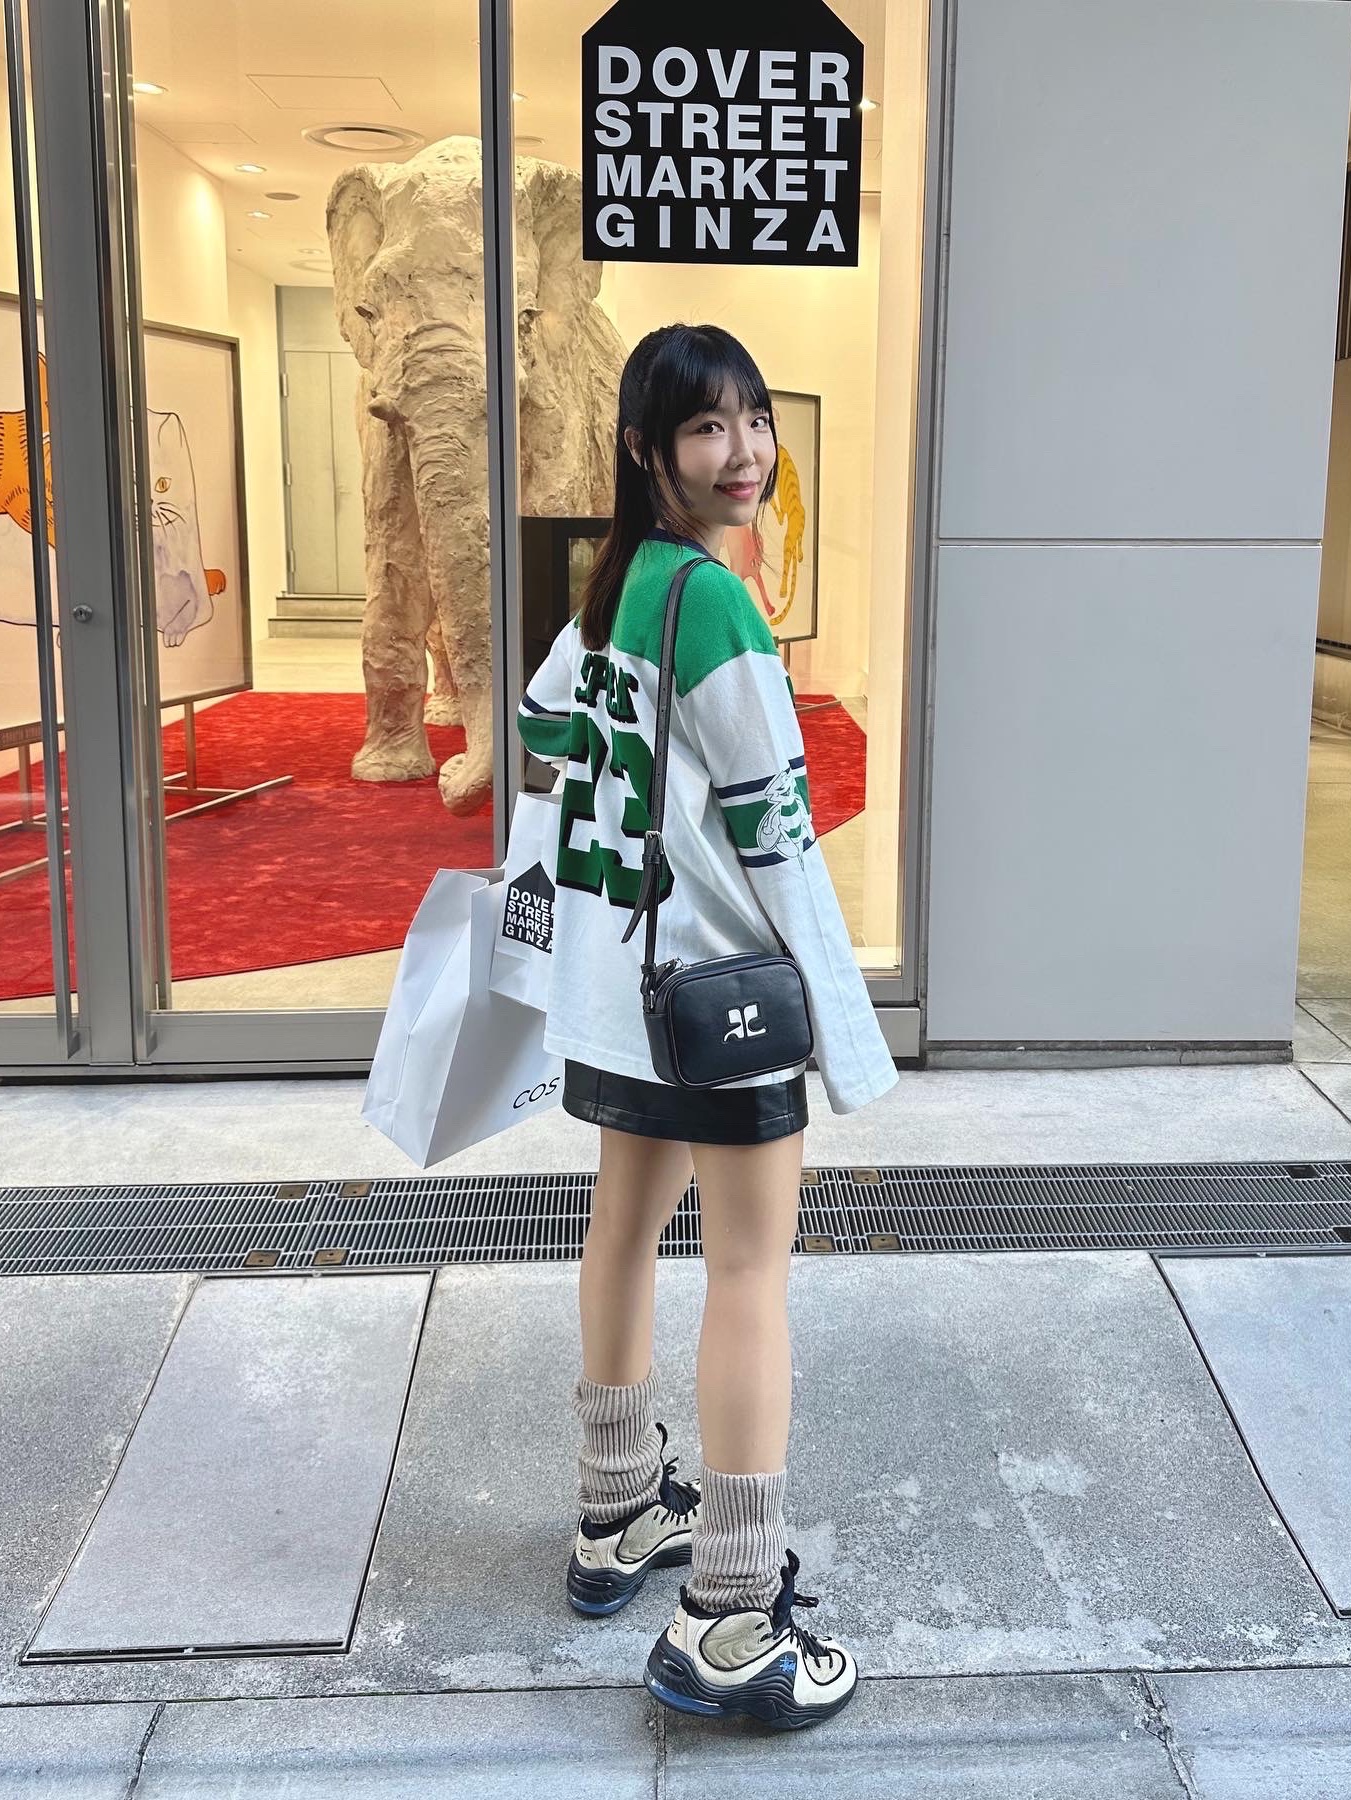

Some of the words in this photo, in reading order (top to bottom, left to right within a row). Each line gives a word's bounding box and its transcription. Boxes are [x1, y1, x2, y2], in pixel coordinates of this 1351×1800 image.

[598, 45, 850, 101] DOVER
[594, 100, 850, 152] STREET
[596, 154, 848, 202] MARKET
[595, 203, 846, 252] GINZA
[513, 1076, 560, 1109] COS
